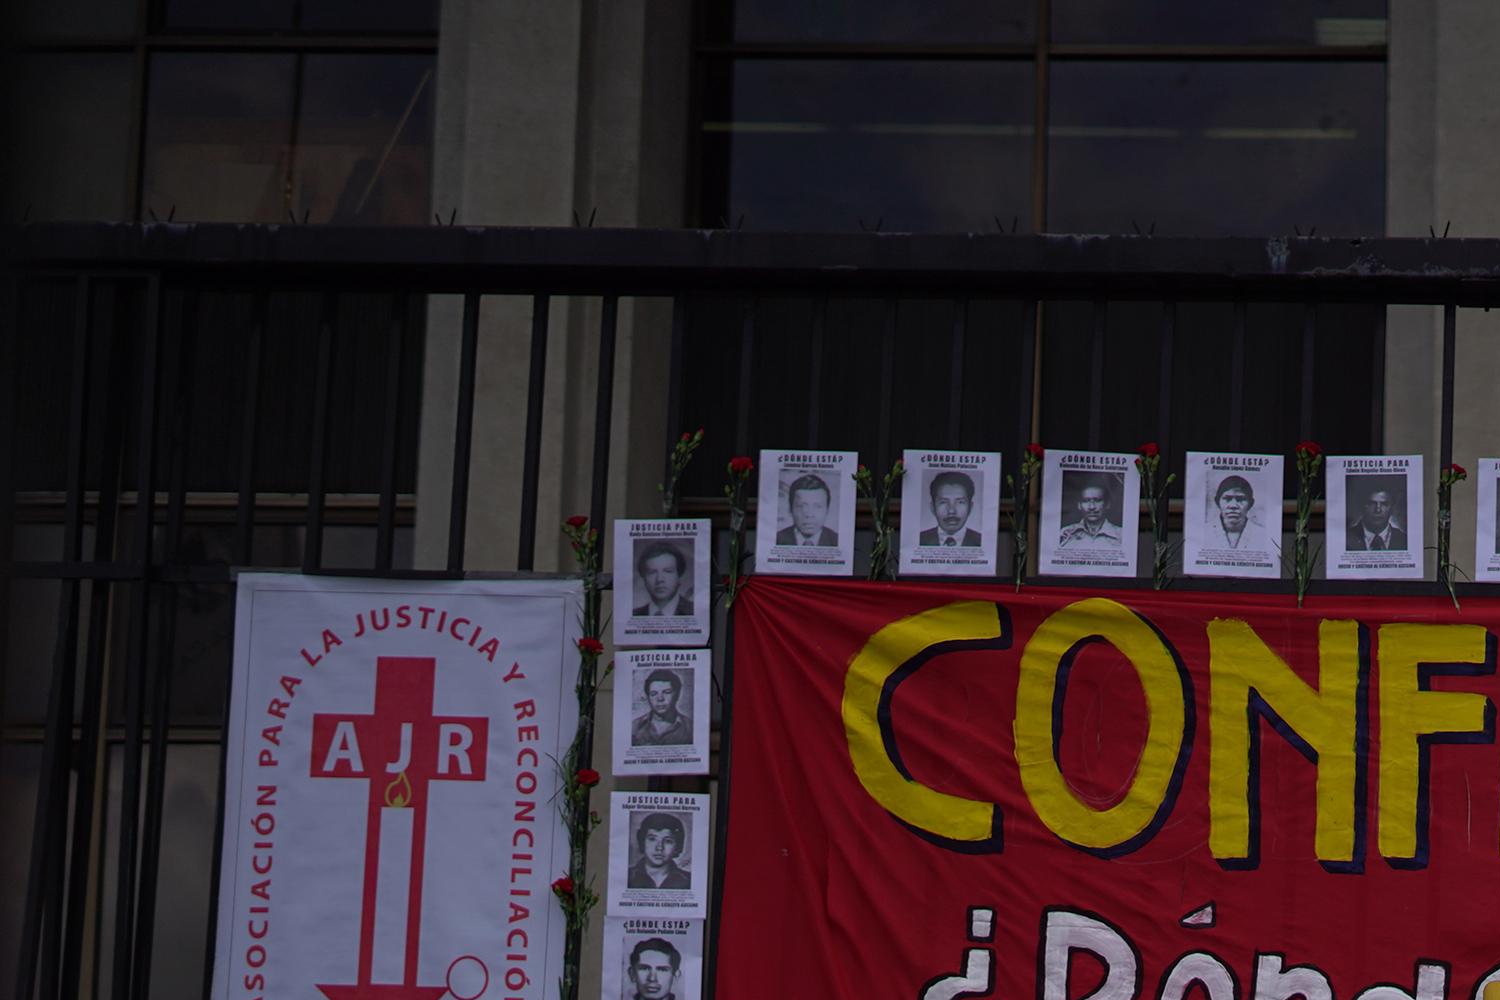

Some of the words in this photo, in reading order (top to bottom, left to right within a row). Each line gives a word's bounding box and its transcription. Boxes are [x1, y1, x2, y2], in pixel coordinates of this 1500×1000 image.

[259, 674, 302, 768] PARA
[299, 628, 343, 667] LA
[353, 605, 502, 663] JUSTICIA
[502, 662, 526, 685] Y
